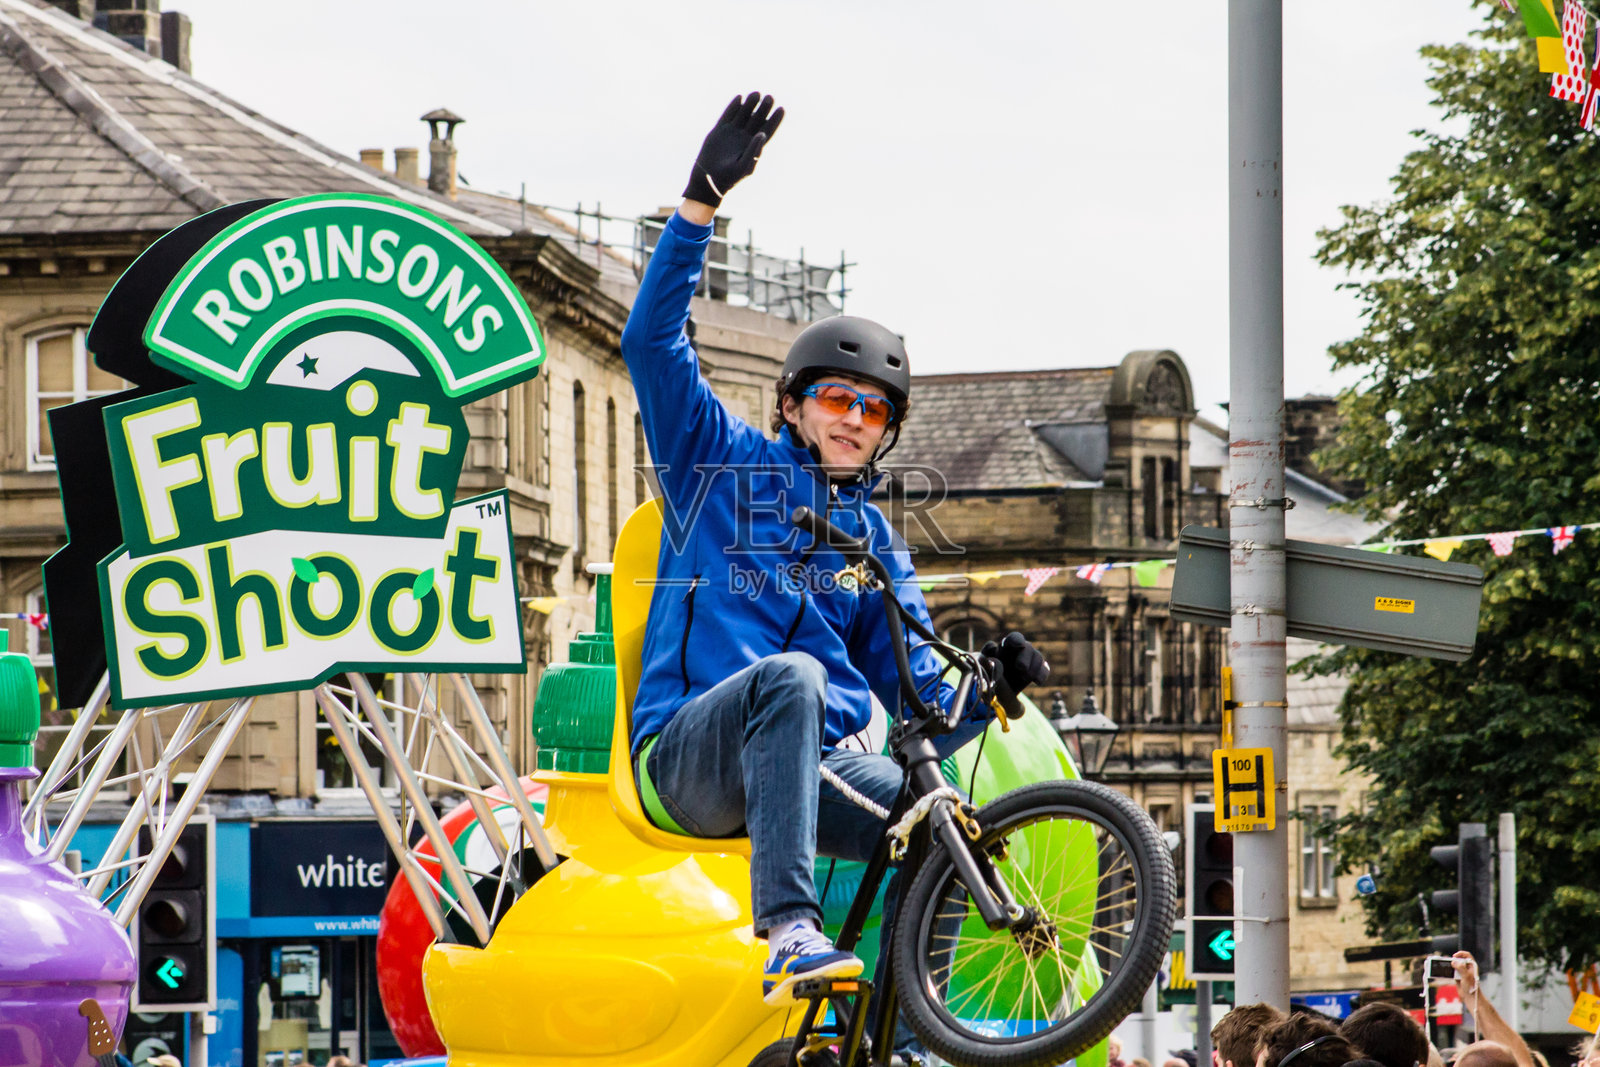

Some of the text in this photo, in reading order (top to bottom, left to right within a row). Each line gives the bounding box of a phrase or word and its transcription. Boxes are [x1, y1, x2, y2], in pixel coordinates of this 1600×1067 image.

[192, 224, 503, 353] ROBINSONS
[122, 380, 451, 543] Fruit
[475, 501, 501, 519] TM
[122, 526, 499, 681] Shoot
[1222, 755, 1266, 819] H
[1232, 759, 1251, 771] 100
[1240, 805, 1247, 815] 3
